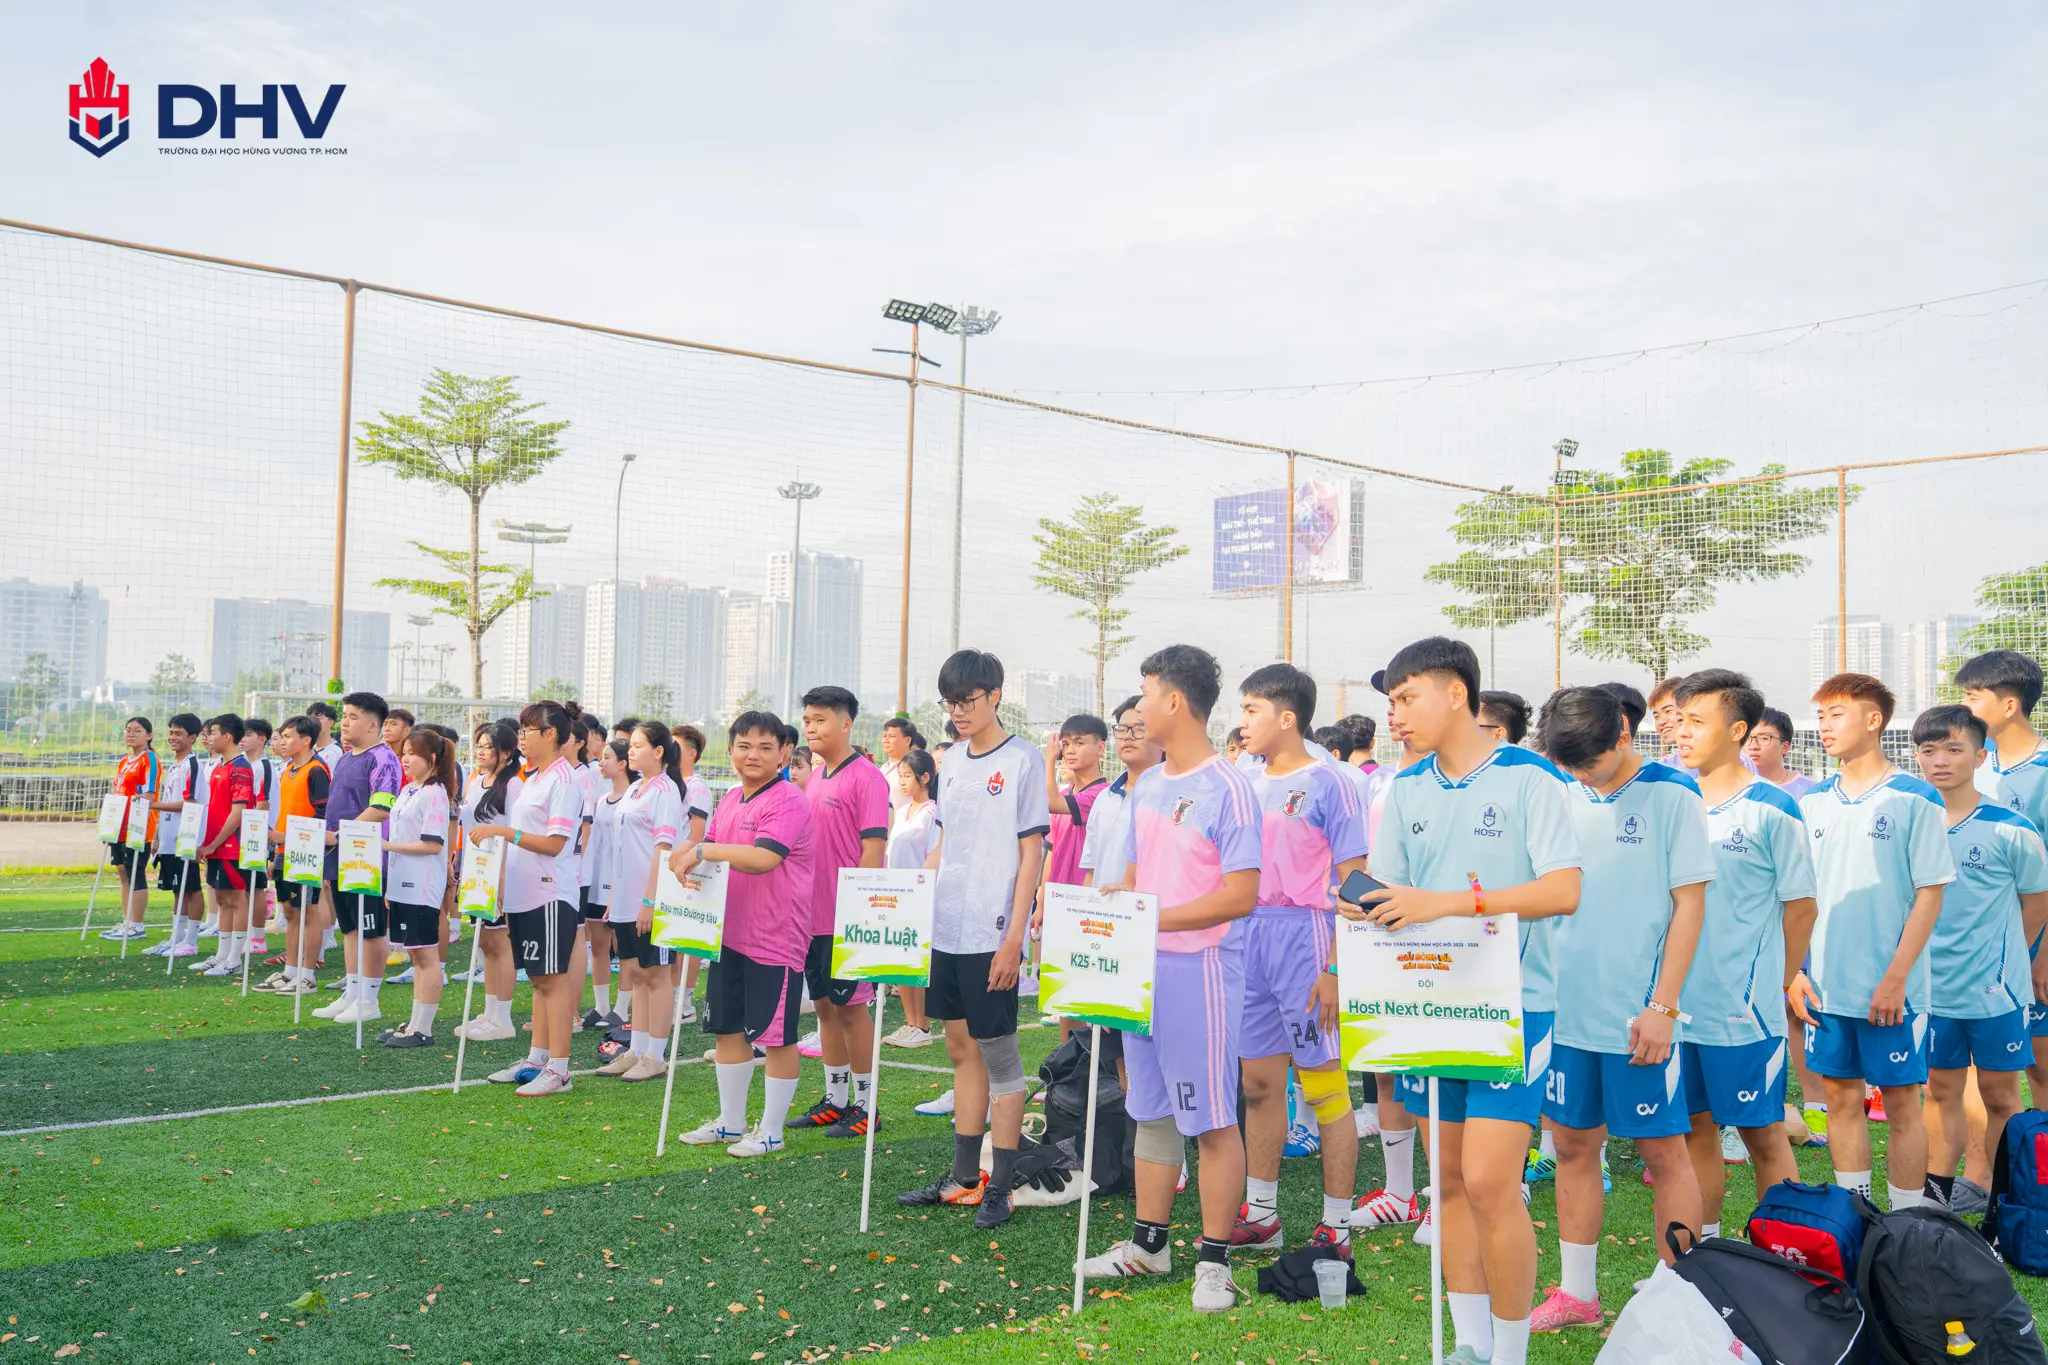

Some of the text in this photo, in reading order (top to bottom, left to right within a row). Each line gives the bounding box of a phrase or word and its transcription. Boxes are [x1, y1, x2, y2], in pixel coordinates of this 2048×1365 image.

[1474, 828, 1503, 837] HOST
[1616, 836, 1644, 844] HOST
[1868, 831, 1891, 841] HOST
[1722, 844, 1748, 853] HOST
[290, 851, 318, 868] BAM FC
[1961, 861, 1987, 869] HOST
[844, 924, 918, 952] Khoa Luật
[522, 940, 540, 960] 22
[1070, 951, 1090, 969] K25
[1098, 957, 1119, 974] TLH
[1418, 979, 1433, 988] ĐỘI
[1349, 1000, 1510, 1021] Host Next Generation
[1291, 1019, 1319, 1049] 24
[1546, 1068, 1566, 1105] 20
[1176, 1081, 1197, 1111] 12
